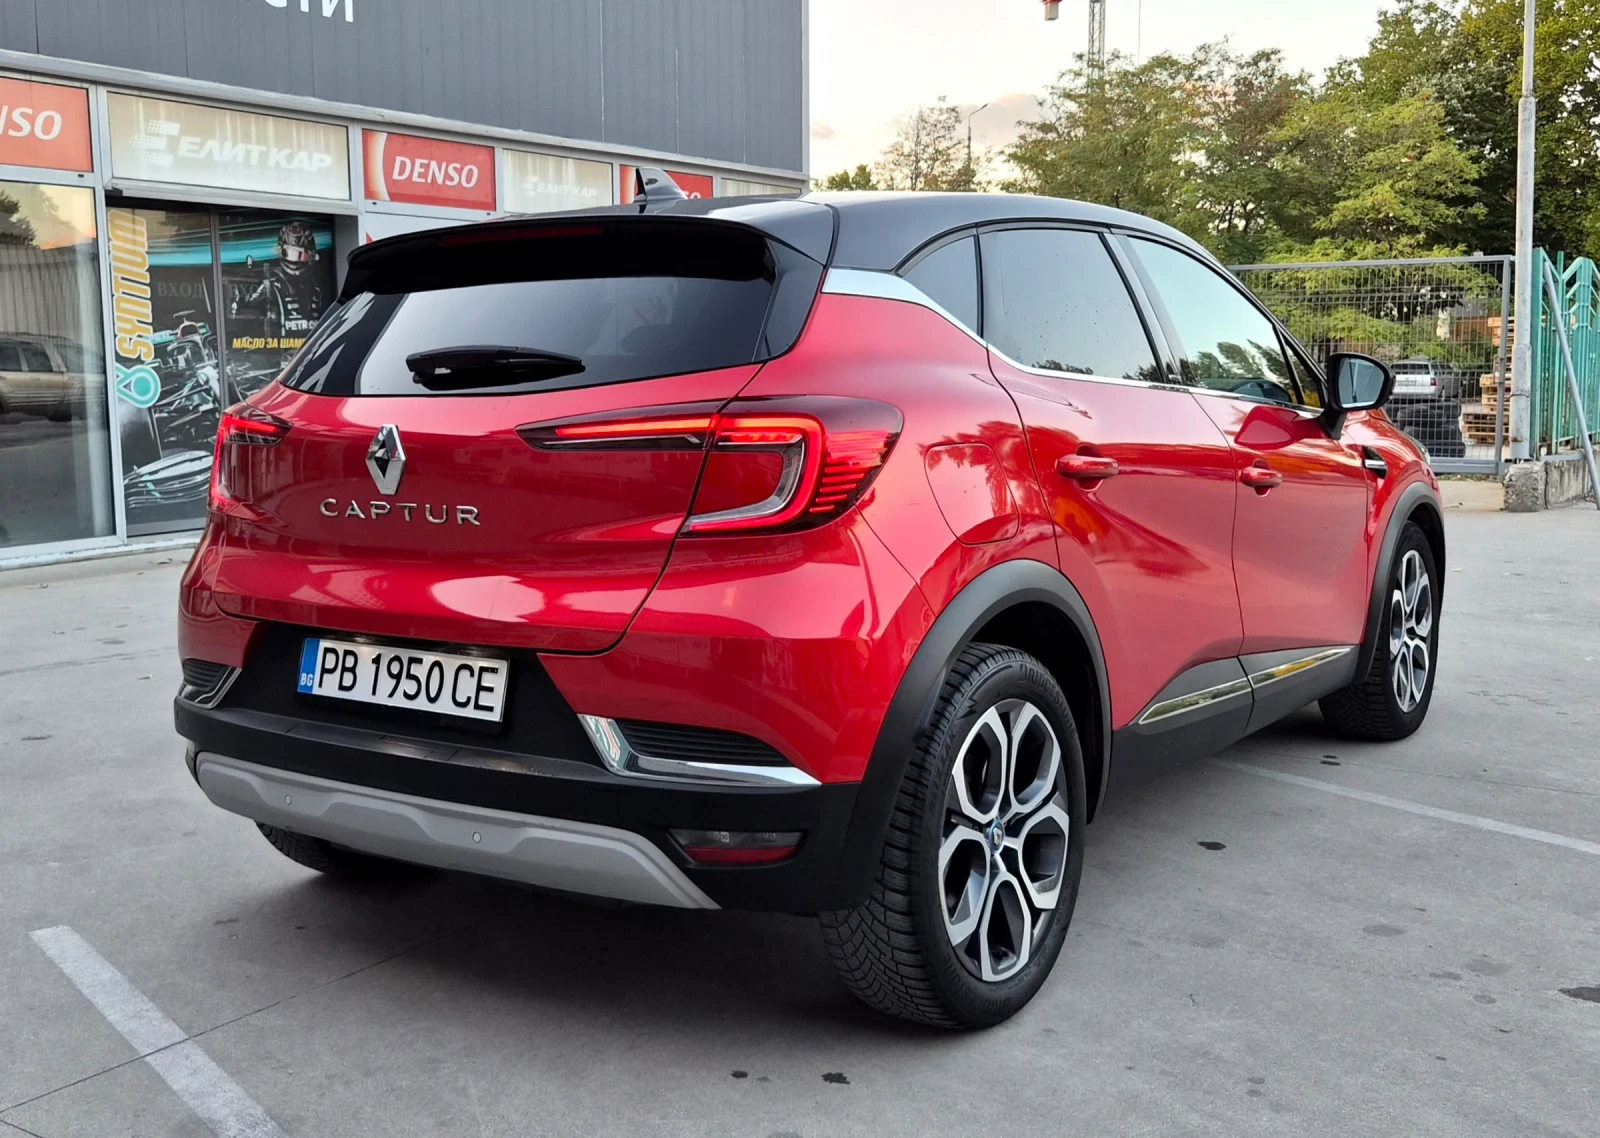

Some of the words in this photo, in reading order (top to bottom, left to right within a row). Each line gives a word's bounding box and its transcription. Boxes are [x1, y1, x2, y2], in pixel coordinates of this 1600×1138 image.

[392, 156, 479, 188] DENSO
[108, 209, 154, 361] SYNTIUM
[232, 338, 264, 349] МАСЛО
[266, 338, 279, 349] ЗА
[319, 498, 481, 526] CAPTUR
[301, 672, 314, 687] BG
[318, 647, 359, 692] PB
[371, 653, 445, 704] 1950
[451, 663, 499, 713] CE
